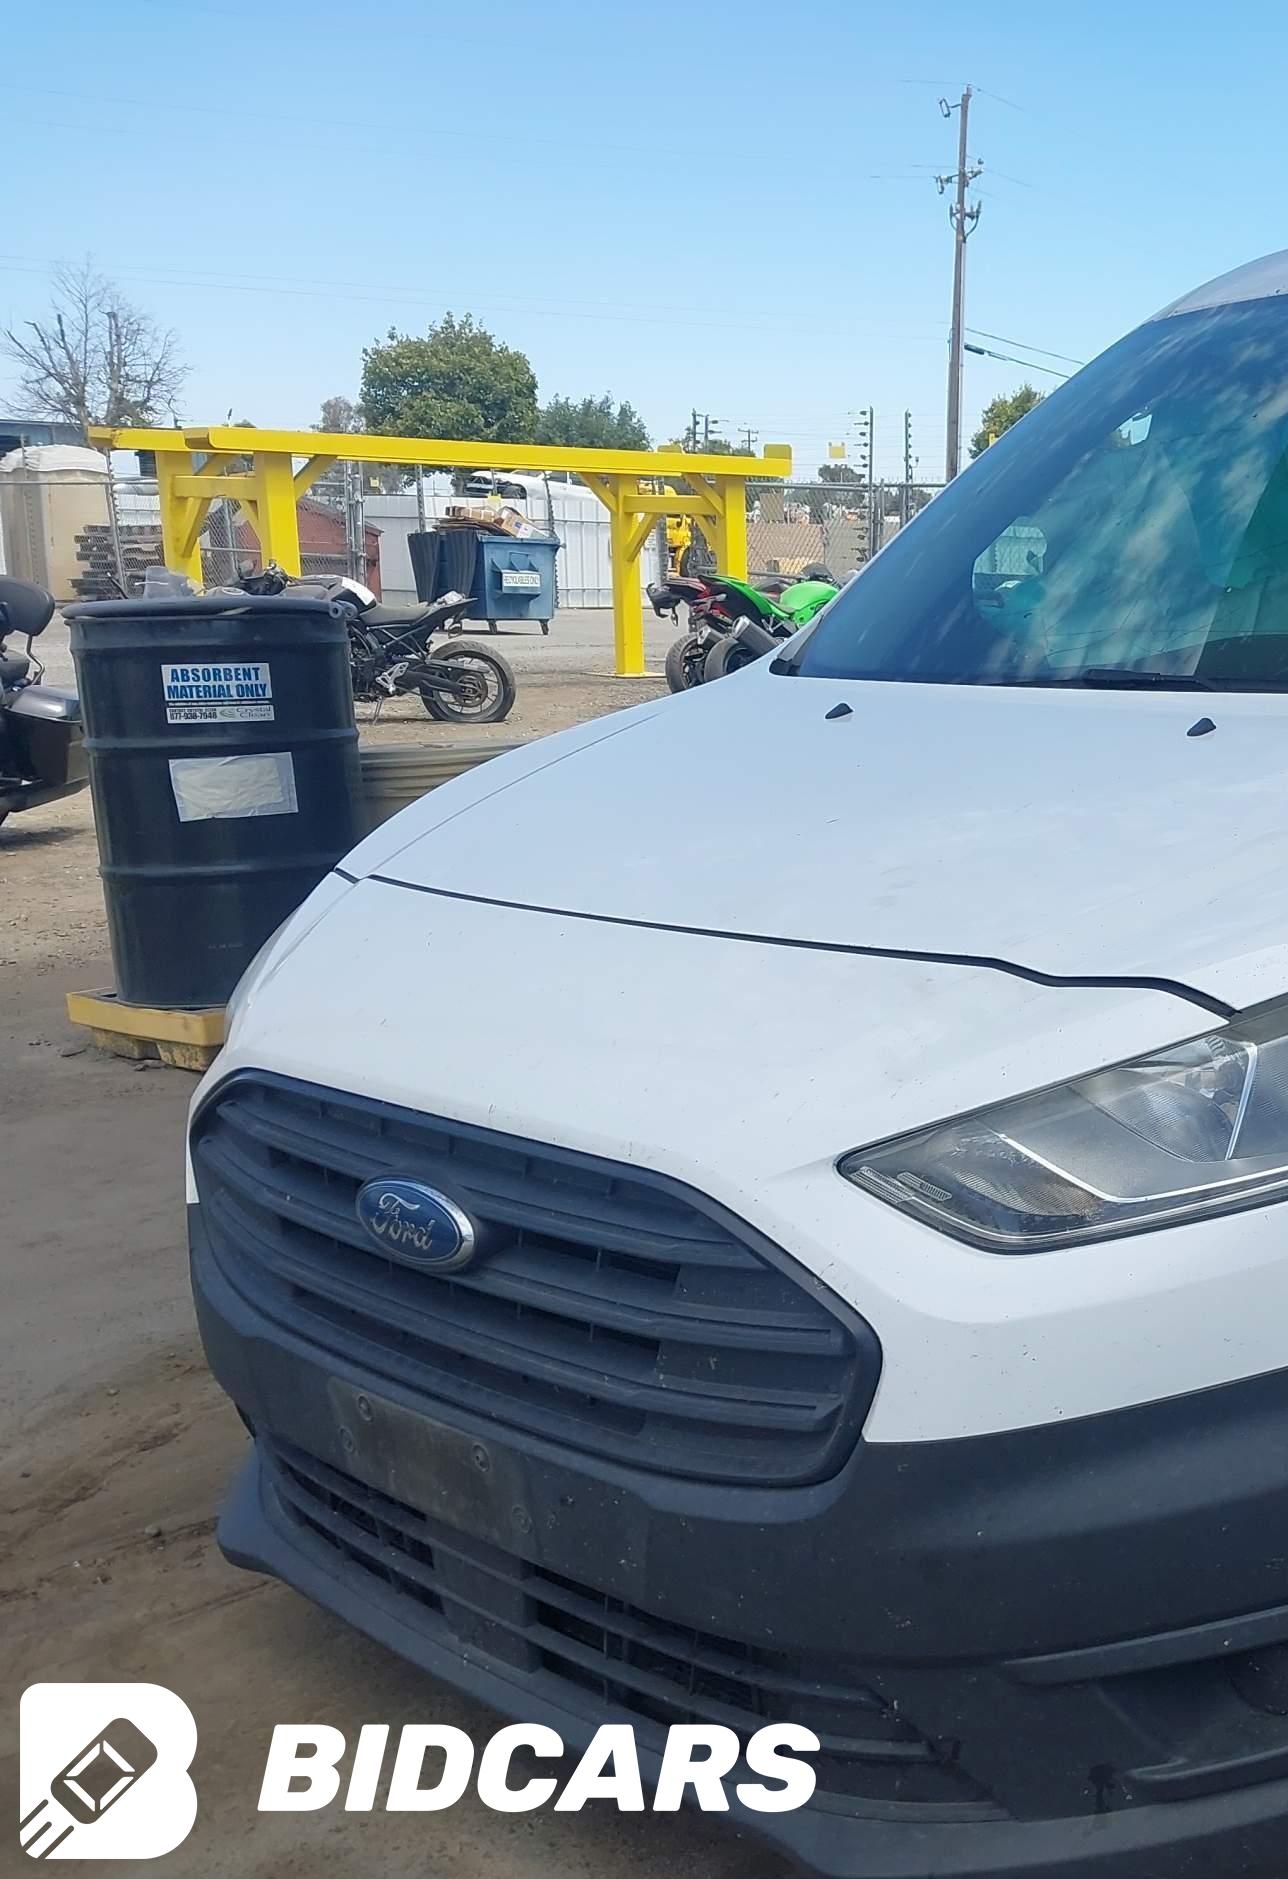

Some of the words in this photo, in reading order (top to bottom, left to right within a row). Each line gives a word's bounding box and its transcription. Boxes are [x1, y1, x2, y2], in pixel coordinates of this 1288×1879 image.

[170, 667, 260, 682] ABSORBENT
[166, 684, 233, 699] MATERIAL
[235, 683, 267, 698] ONLY
[370, 1192, 437, 1250] Ford
